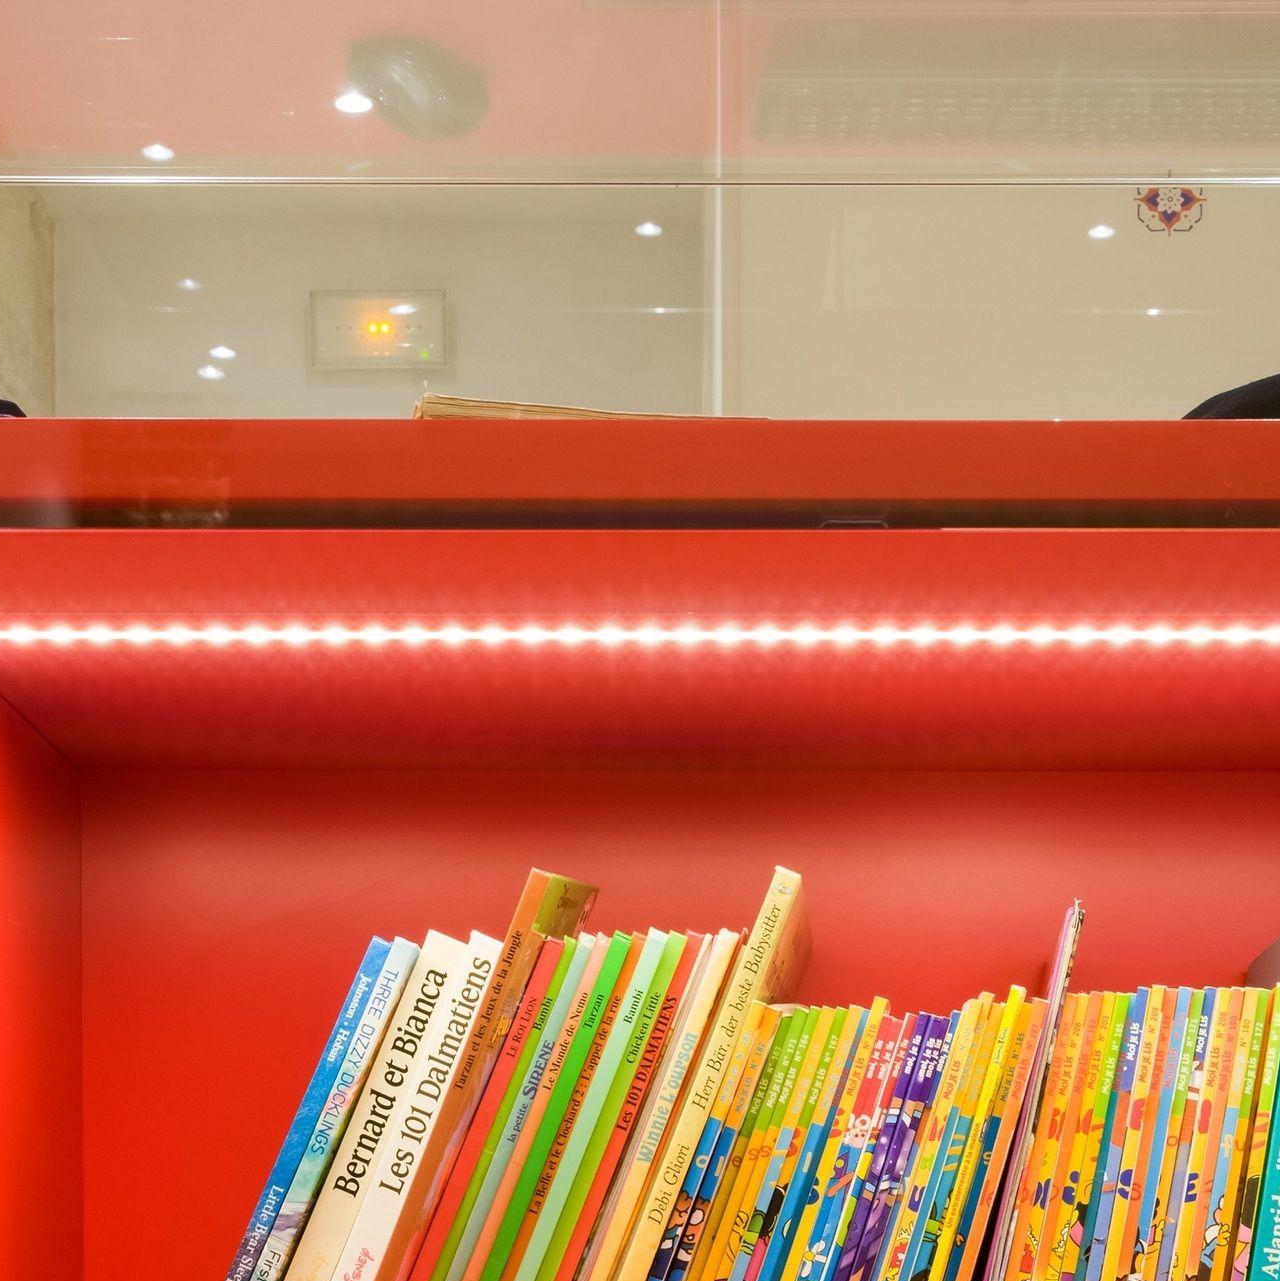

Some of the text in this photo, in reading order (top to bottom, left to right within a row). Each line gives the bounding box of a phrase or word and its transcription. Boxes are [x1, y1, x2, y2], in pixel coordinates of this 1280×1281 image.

[308, 966, 397, 1157] THREE DIZZY DUCKLINGS
[333, 963, 451, 1198] Bernard et Bianca
[379, 953, 495, 1196] Les 101 Dalmatiens
[693, 901, 786, 1111] Herr Bär, der beste Babysitter
[647, 1140, 693, 1225] Debi Gliori
